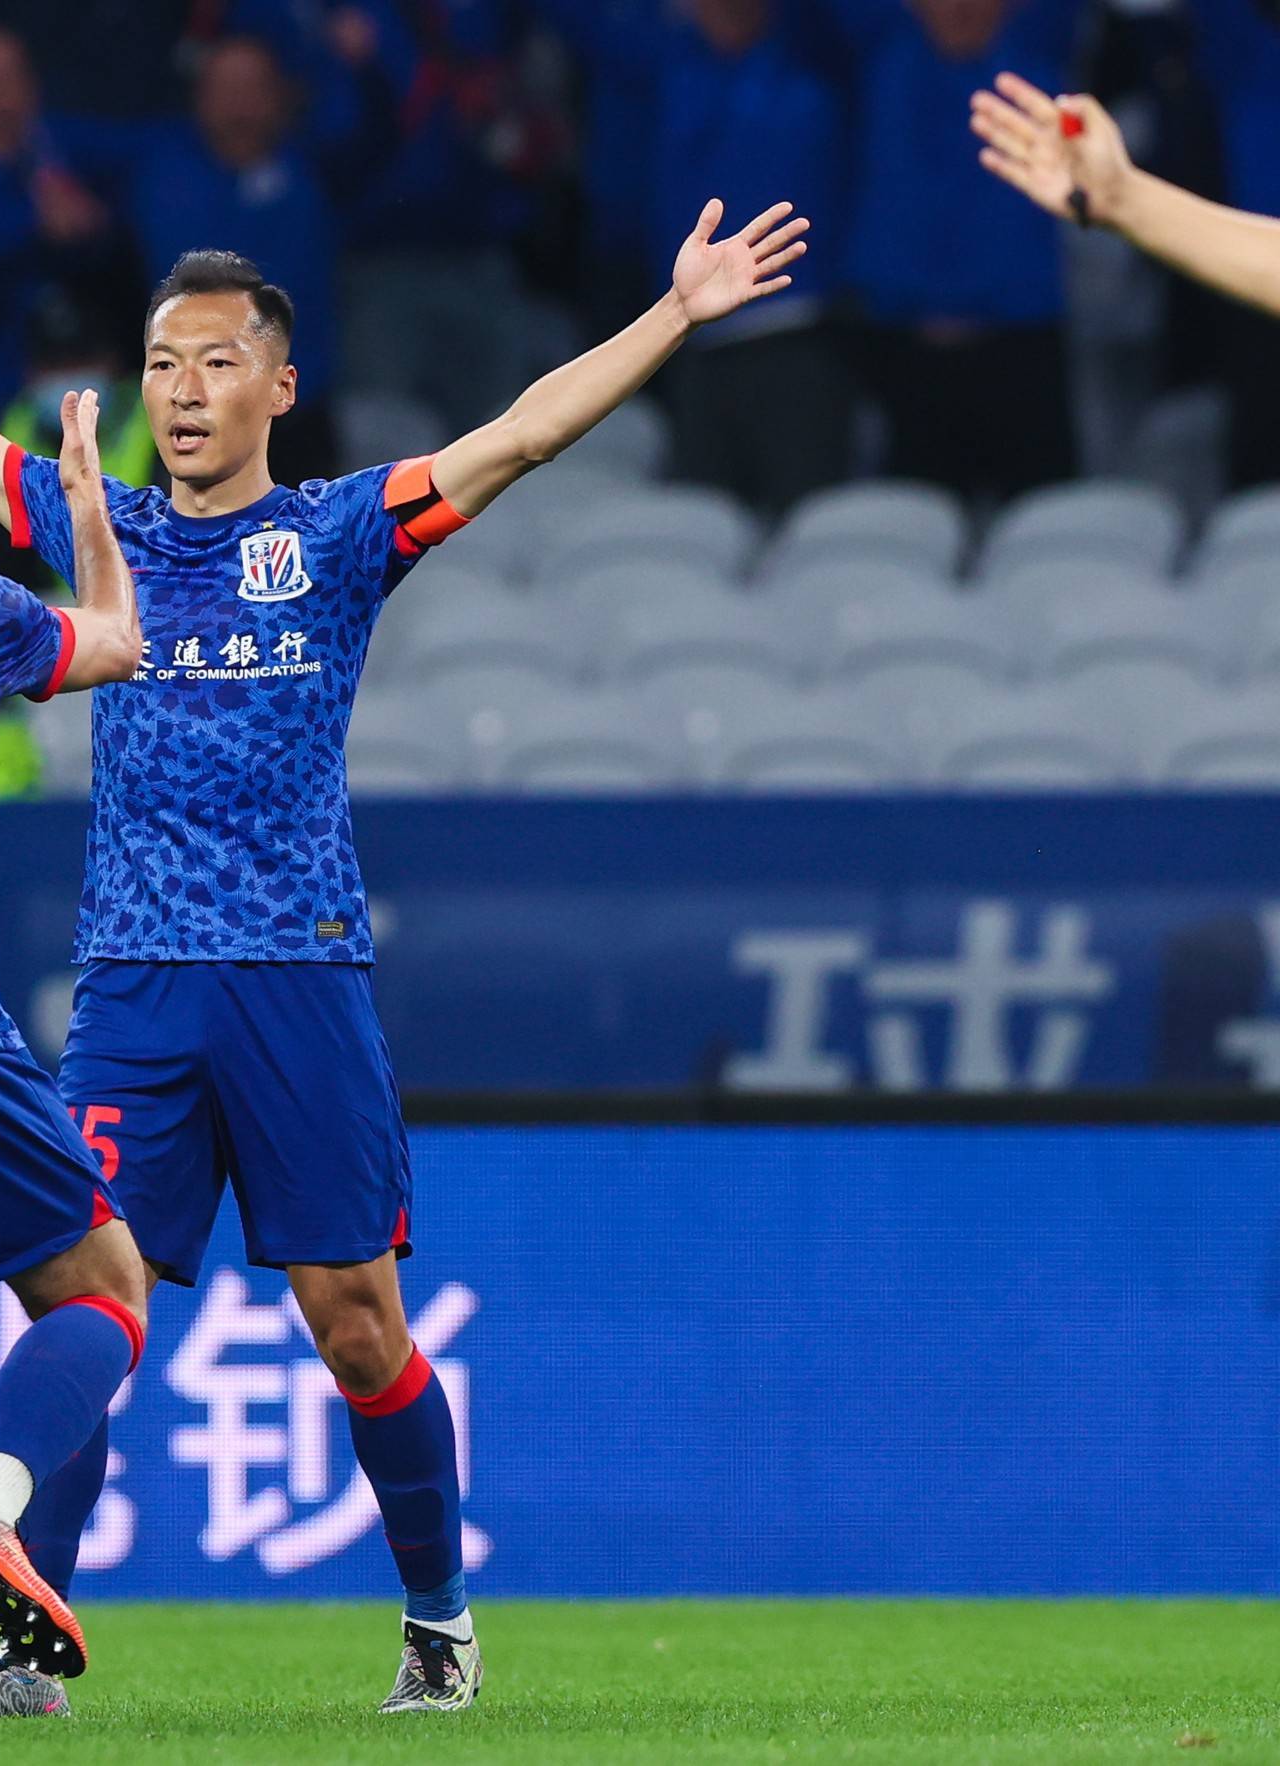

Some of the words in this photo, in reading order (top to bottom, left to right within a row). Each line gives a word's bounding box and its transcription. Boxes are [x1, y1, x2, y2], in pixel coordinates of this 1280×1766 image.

[130, 670, 148, 681] NK
[156, 669, 177, 681] OF
[185, 661, 321, 680] COMMUNICATIONS
[67, 1105, 122, 1182] 5
